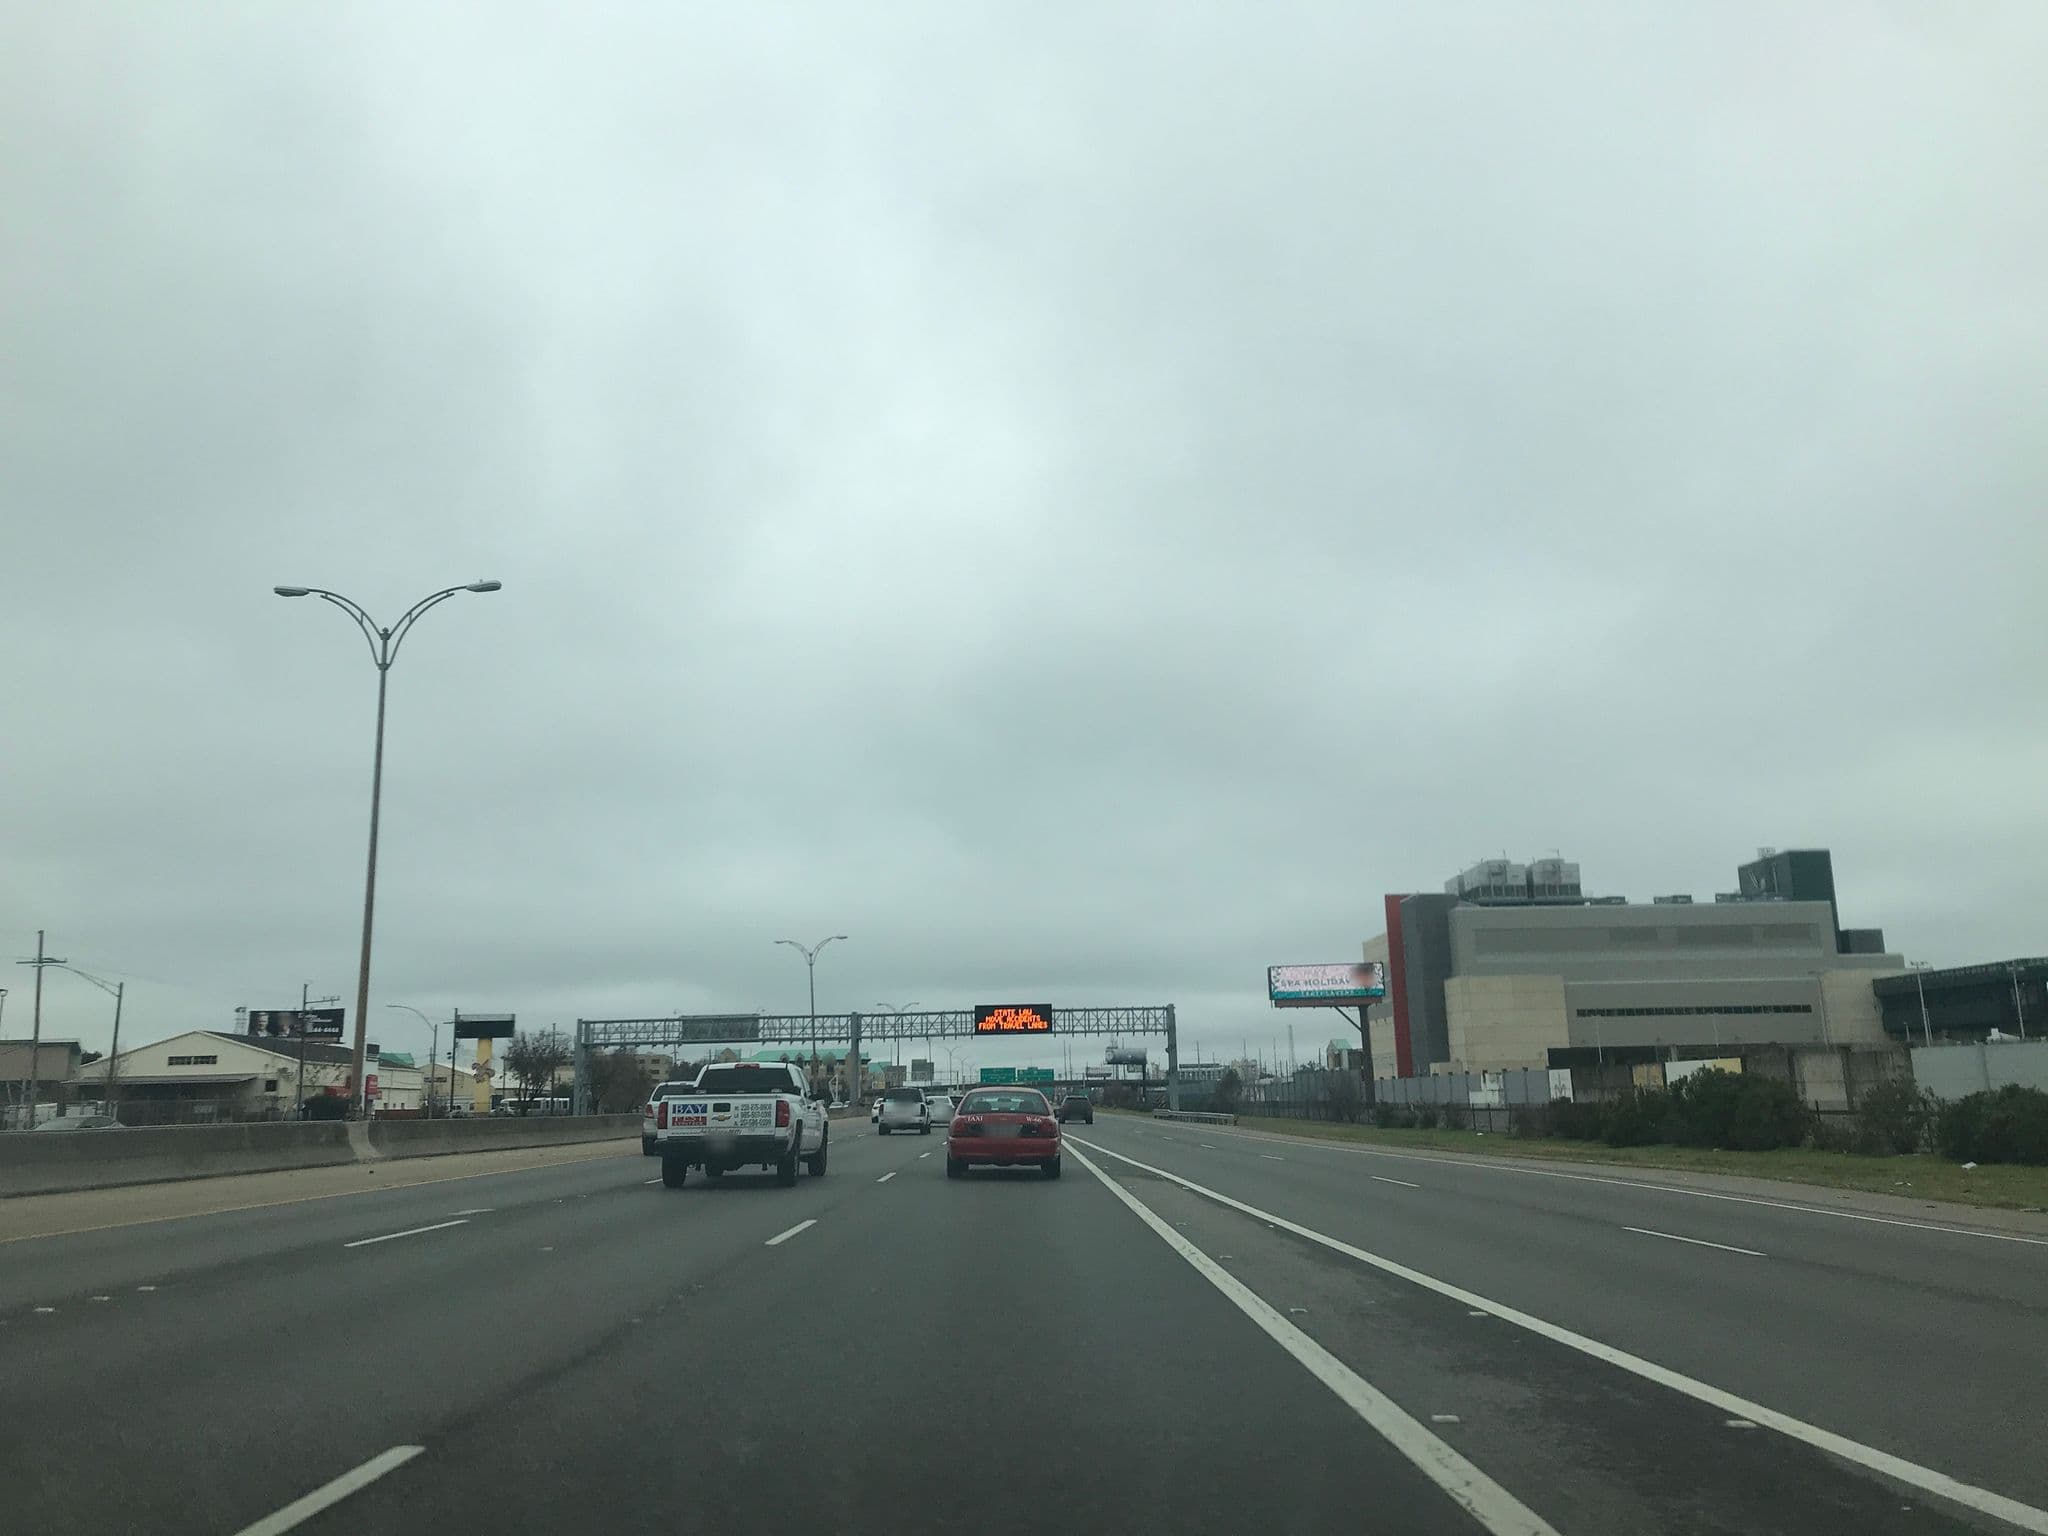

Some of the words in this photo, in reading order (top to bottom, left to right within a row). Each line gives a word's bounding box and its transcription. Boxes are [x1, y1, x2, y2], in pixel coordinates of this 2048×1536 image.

[994, 1009, 1016, 1017] STATE
[1006, 1014, 1041, 1023] ACCIDENTS
[978, 1022, 996, 1030] FROM
[1027, 1021, 1048, 1030] LANES
[675, 1104, 705, 1114] BAY
